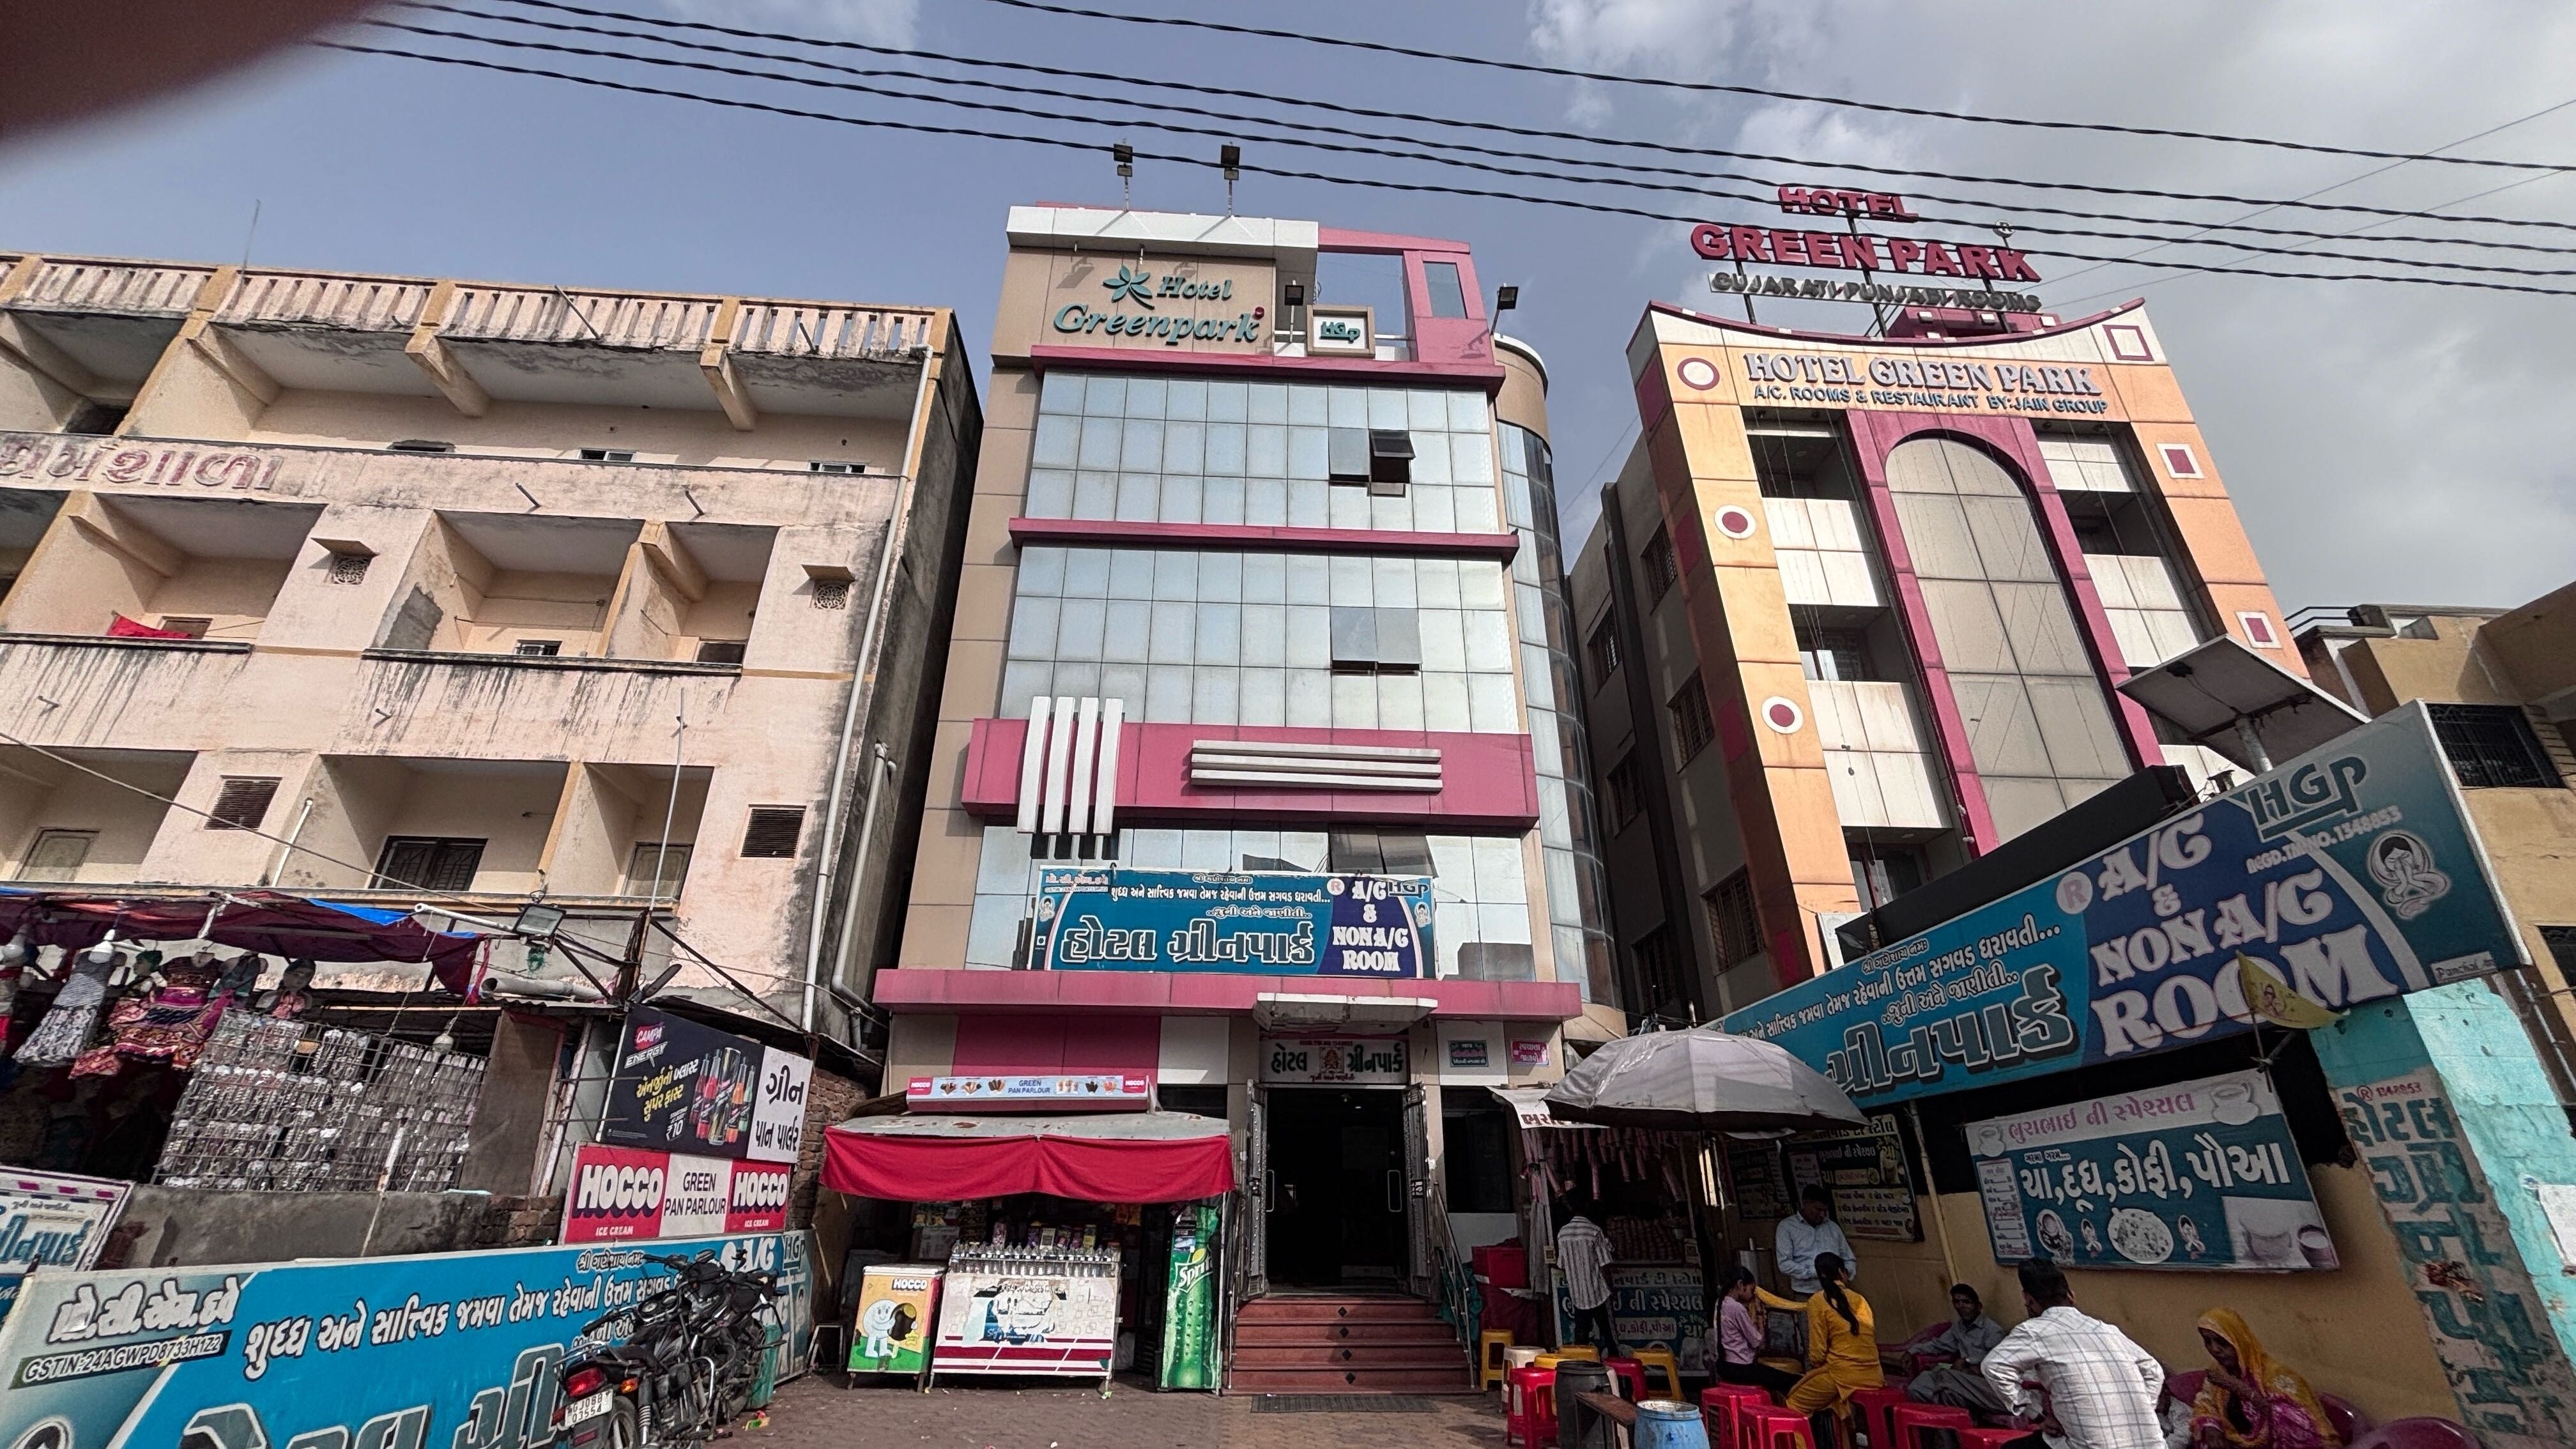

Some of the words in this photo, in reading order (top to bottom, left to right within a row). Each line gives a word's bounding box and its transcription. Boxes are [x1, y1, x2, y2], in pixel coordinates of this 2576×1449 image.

[1777, 184, 1919, 222] HOTEL
[1690, 224, 1880, 271] GREEN
[1887, 238, 2042, 282] PARK
[1156, 276, 1232, 300] Hotel
[1054, 303, 1261, 346] Greenpark
[1743, 353, 1866, 385] HOTEL
[1869, 357, 1993, 392] GREEN
[1994, 364, 2103, 397] PARK
[1790, 387, 1851, 404] ROOMS
[1855, 390, 1867, 404] &
[1872, 390, 1979, 410] RESTAURANT
[2052, 399, 2110, 415] GROUP
[2247, 756, 2367, 839] HGP
[1130, 884, 1146, 898] અને
[1177, 887, 1198, 900] જમવા
[1199, 885, 1218, 901] તેમજ
[1220, 886, 1246, 901] રહેવાની
[1248, 887, 1267, 902] ઉત્તમ
[1268, 889, 1293, 903] સગવડ
[1239, 905, 1262, 917] અને
[1060, 915, 1157, 962] હોટલ
[1167, 918, 1315, 964] ગ્રીનપાર્ક
[1342, 950, 1400, 972] ROOM
[1798, 1002, 1825, 1024] જમવા
[1825, 993, 1851, 1018] તેમજ
[1853, 972, 1894, 1008] રહેવાની
[1895, 965, 1927, 992] ઉત્તમ
[1929, 942, 1975, 978] સગવડ
[1917, 983, 1947, 1011] અને
[636, 1025, 664, 1044] CAMPA
[624, 1041, 669, 1070] ENERGY
[1271, 1043, 1307, 1073] હોટલ
[1347, 1042, 1404, 1073] ગ્રીનપાર્ક
[766, 1064, 805, 1105] ગ્રીન
[2086, 1102, 2109, 1126] ની
[2342, 1092, 2457, 1147] હોટલ
[756, 1121, 775, 1149] પાન
[574, 1164, 664, 1216] HOCCO
[683, 1172, 716, 1192] GREEN
[731, 1172, 788, 1211] HOCCO
[664, 1198, 684, 1217] PAN
[686, 1197, 726, 1216] PARLOUR
[595, 1227, 608, 1236] ICE
[609, 1225, 634, 1236] CREAM
[892, 1278, 928, 1291] HOCCO
[316, 1298, 368, 1353] અને
[456, 1295, 507, 1331] જમવા
[509, 1282, 550, 1322] તેમજ
[551, 1276, 602, 1317] રહેવાની
[604, 1276, 634, 1307] ઉત્તમ
